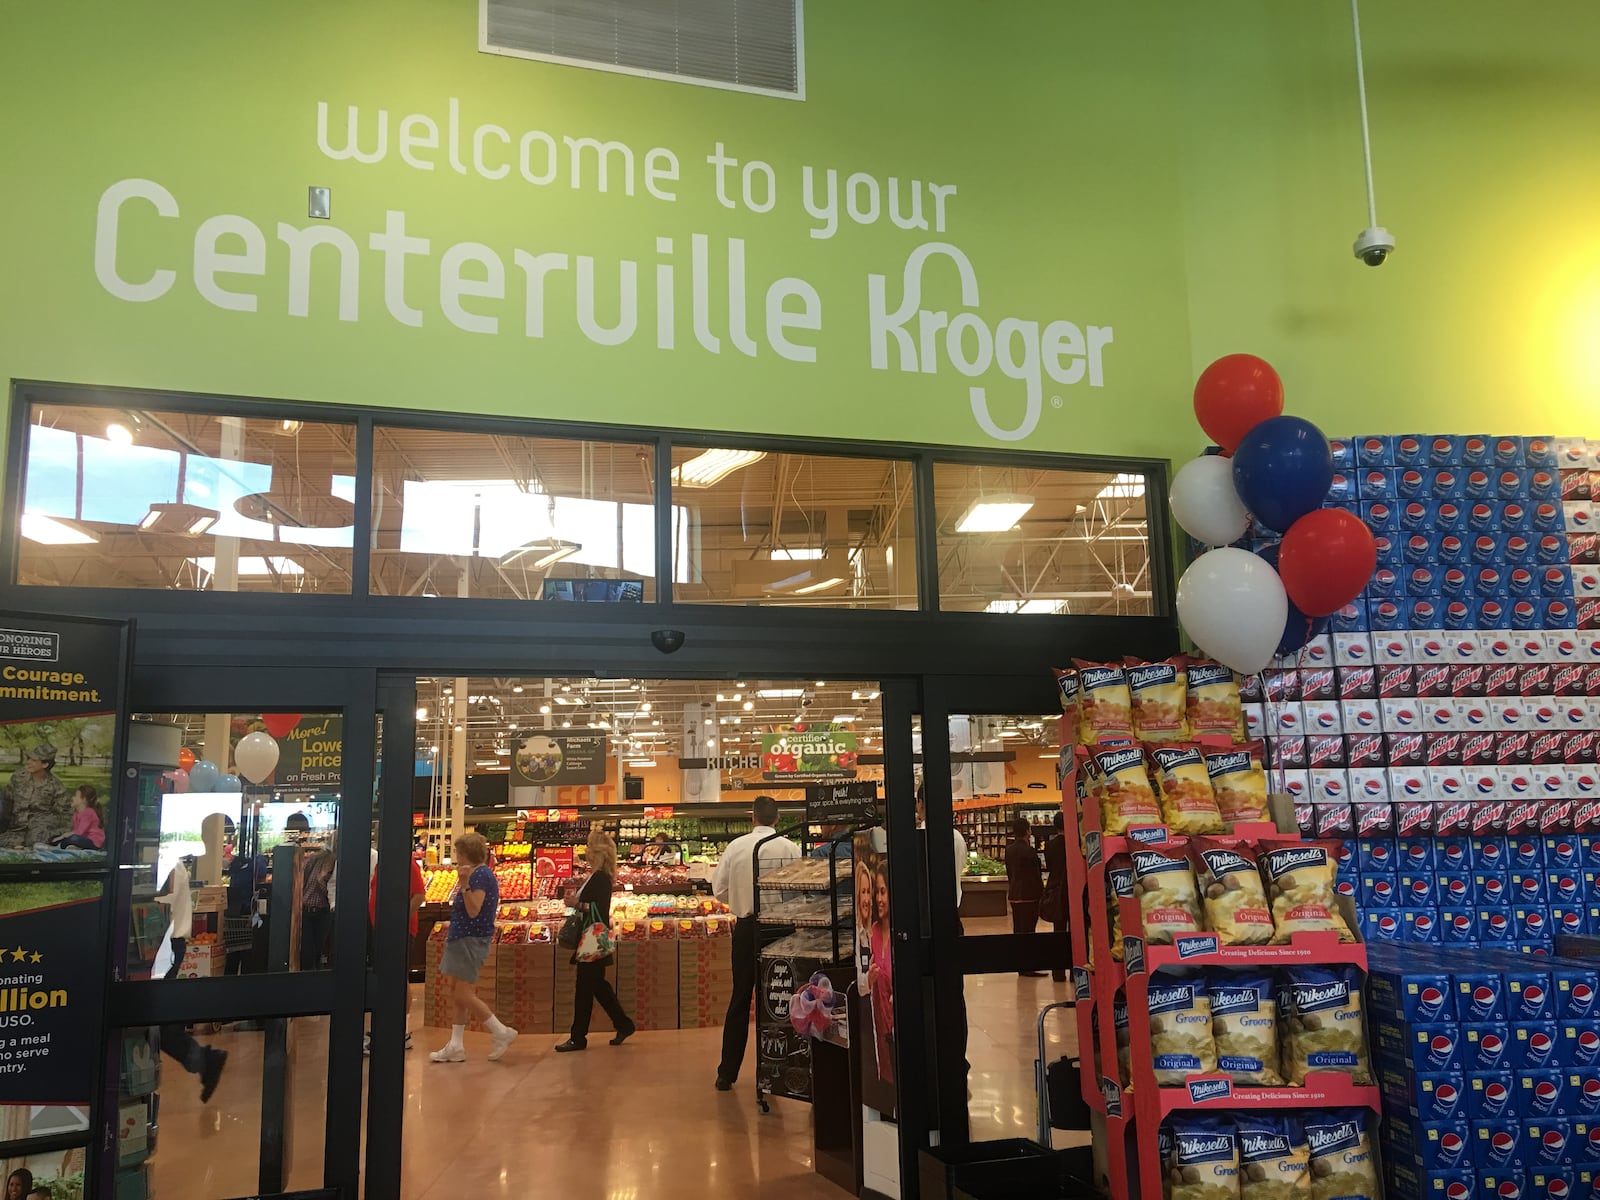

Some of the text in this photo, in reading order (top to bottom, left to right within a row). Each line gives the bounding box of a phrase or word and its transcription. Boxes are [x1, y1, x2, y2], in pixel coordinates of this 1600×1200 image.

[316, 97, 957, 240] welcome to your
[94, 178, 1113, 441] Centerville Kroger
[0, 634, 52, 646] ONORING
[13, 646, 52, 656] HEROES
[3, 666, 87, 686] Courage.
[287, 719, 330, 740] More!
[770, 739, 846, 758] organic
[301, 772, 326, 781] Fresh
[1153, 914, 1187, 922] Original
[1240, 913, 1269, 922] Original
[21, 1033, 51, 1045] meal
[16, 1048, 49, 1058] serve
[1160, 1059, 1194, 1068] Original
[1221, 1060, 1257, 1069] Original
[1315, 1056, 1351, 1064] Original
[1232, 1093, 1260, 1101] Creating
